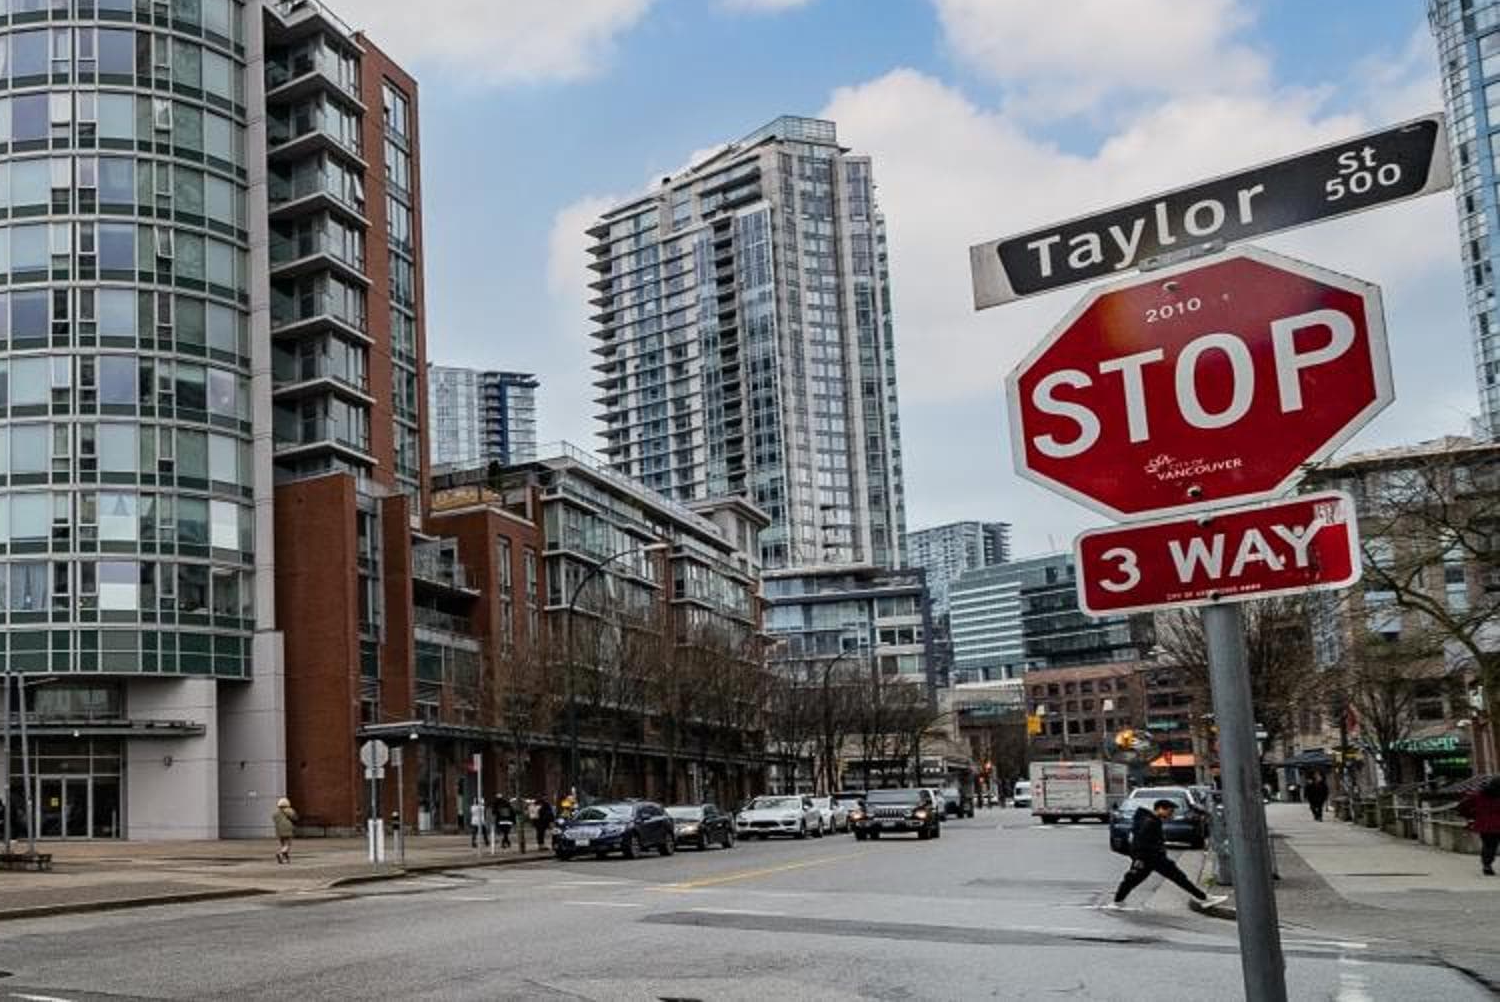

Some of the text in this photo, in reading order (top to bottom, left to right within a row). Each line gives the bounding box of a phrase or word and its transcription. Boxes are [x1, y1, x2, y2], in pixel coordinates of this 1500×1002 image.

[1337, 145, 1377, 175] St
[1325, 163, 1401, 201] 500
[1027, 183, 1265, 278] Taylor
[1145, 297, 1201, 323] 2010
[1031, 308, 1357, 459] STOP
[1157, 458, 1243, 480] VANCOUVER
[1098, 518, 1325, 592] 3 WAY
